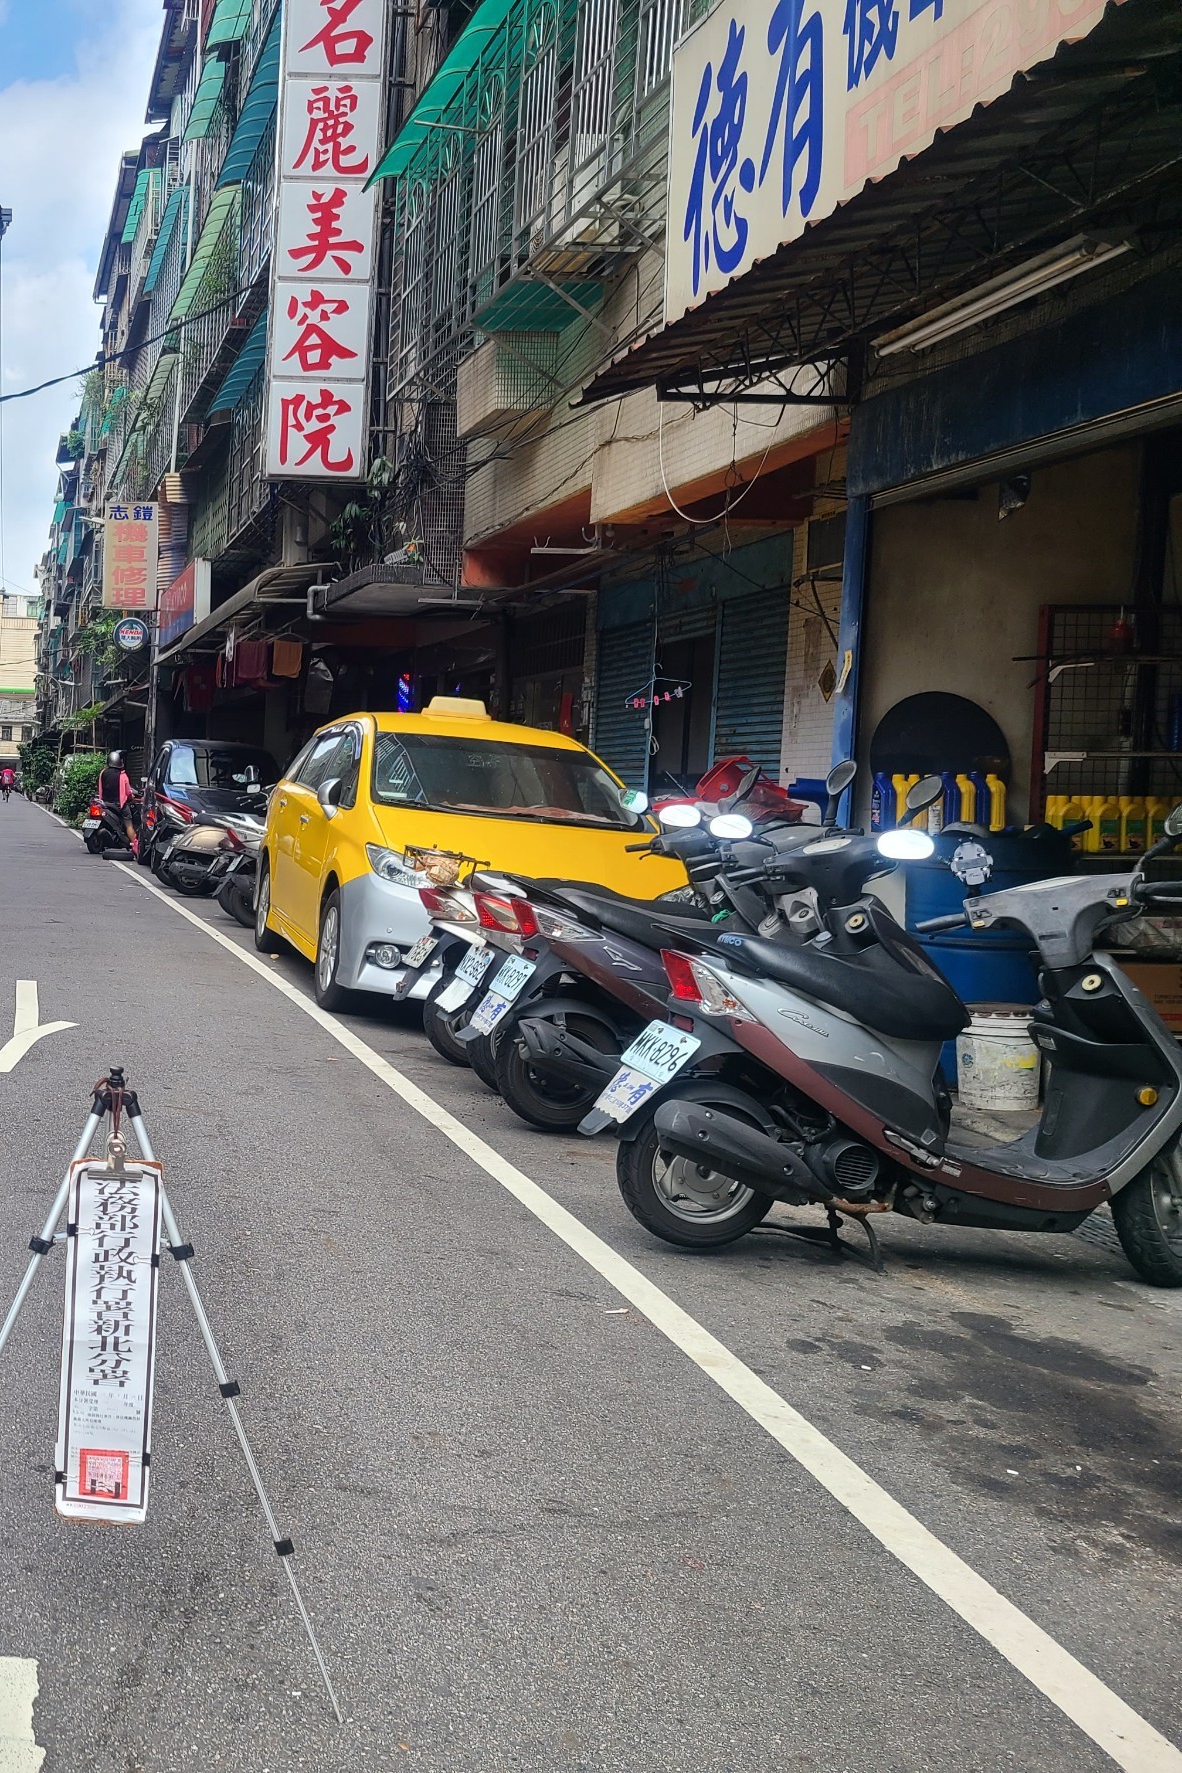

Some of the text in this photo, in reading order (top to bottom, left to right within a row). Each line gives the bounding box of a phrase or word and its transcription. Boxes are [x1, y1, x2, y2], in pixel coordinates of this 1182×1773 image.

[108, 504, 154, 521] 志鎧
[111, 522, 149, 607] 機車修理
[629, 1031, 689, 1073] MKK-8296
[85, 1180, 141, 1388] 法務部行政執行署新北分署
